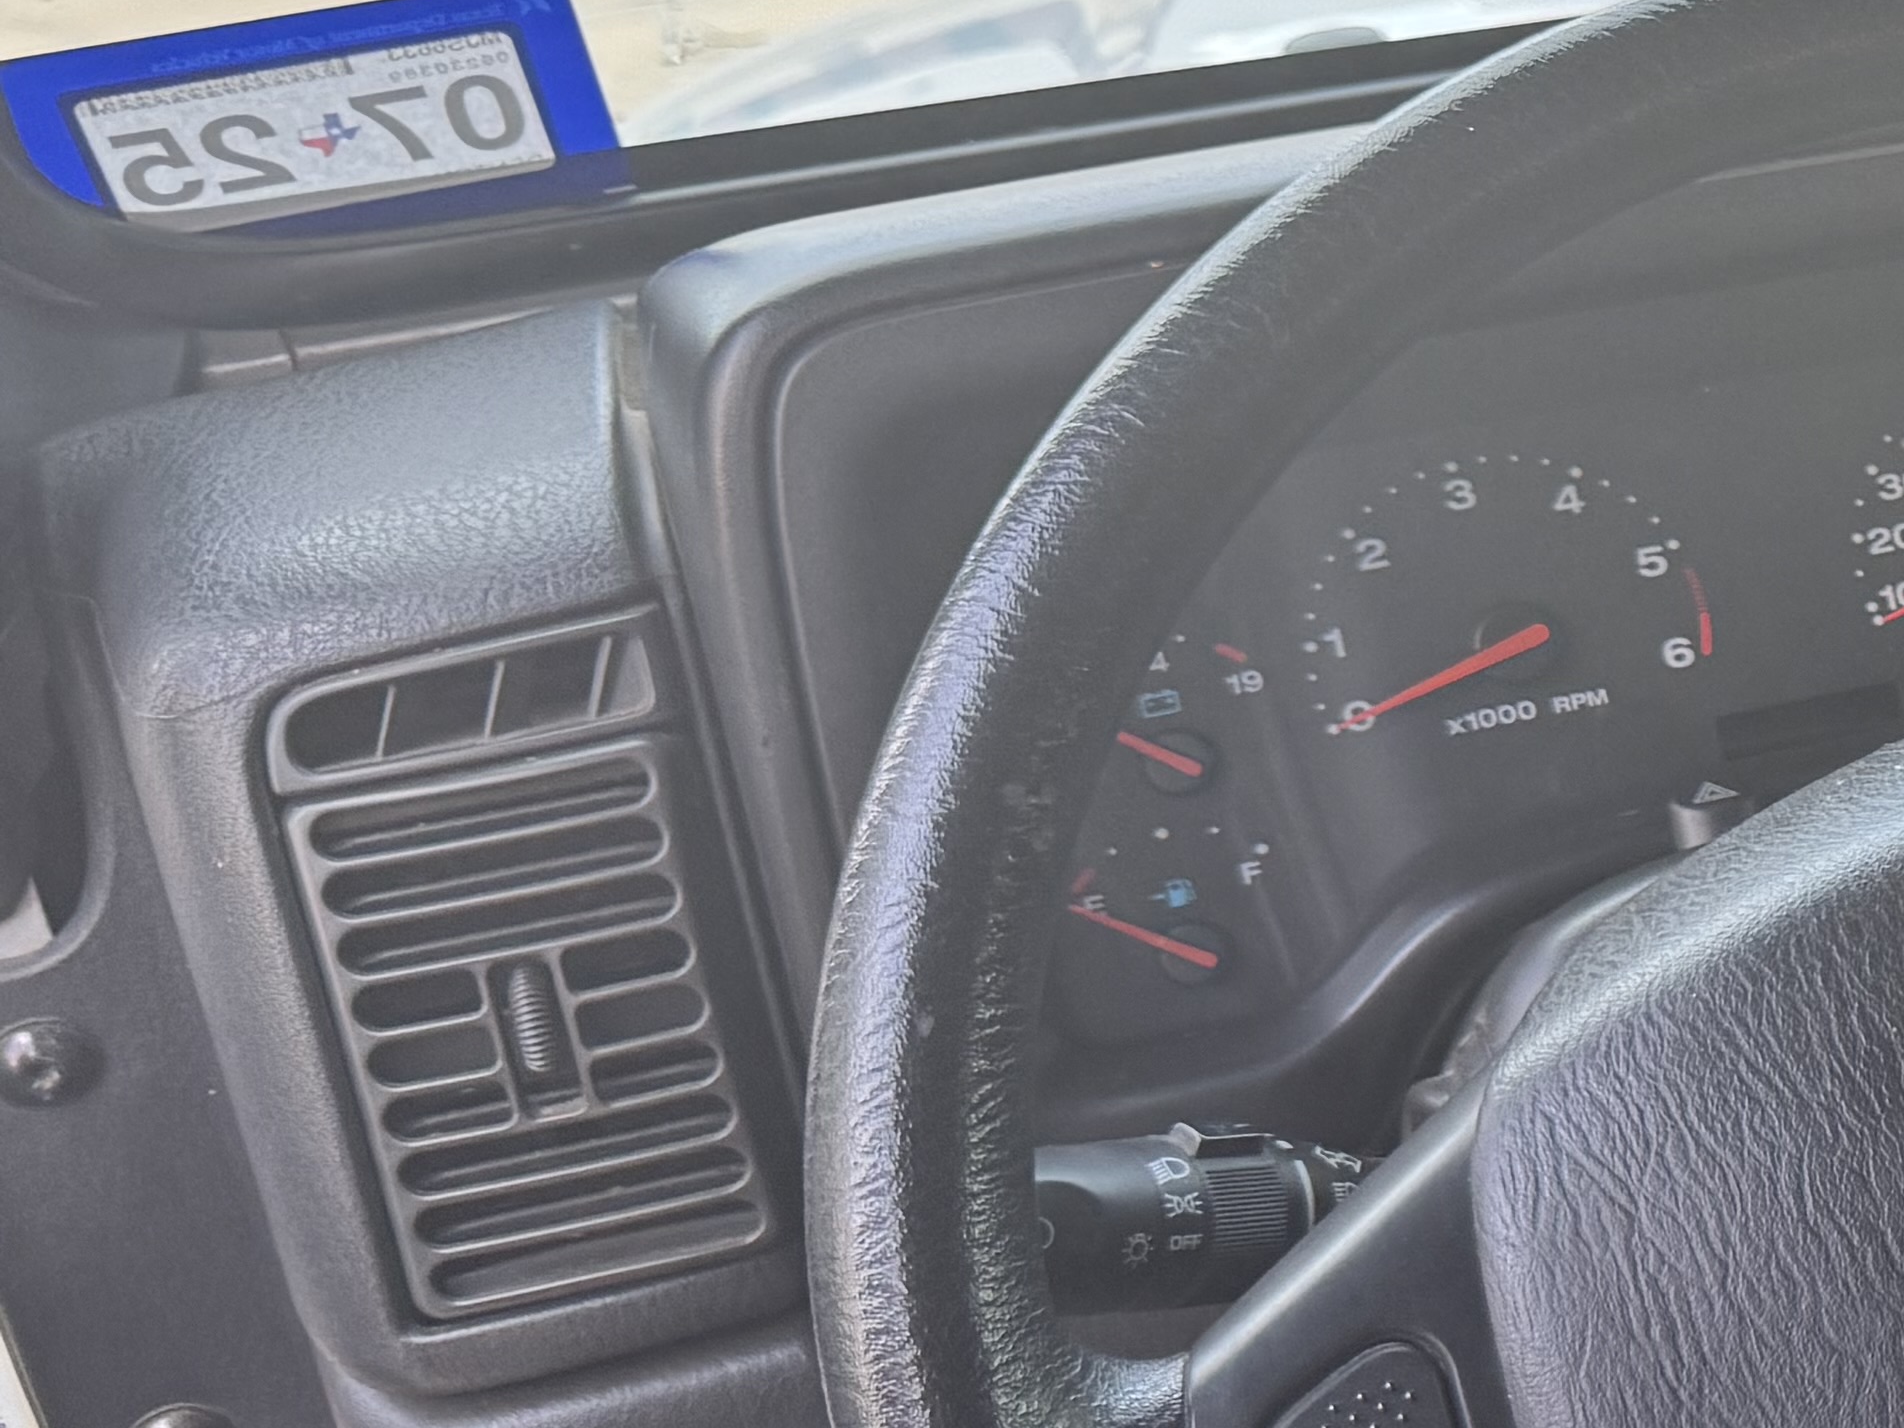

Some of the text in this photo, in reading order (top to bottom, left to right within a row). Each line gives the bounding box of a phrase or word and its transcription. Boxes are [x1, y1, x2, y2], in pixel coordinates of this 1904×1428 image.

[1444, 479, 1477, 510] 3
[1552, 485, 1586, 513] 4
[1355, 538, 1391, 571] 2
[1636, 545, 1668, 577] 5
[1322, 628, 1347, 658] 1
[1662, 637, 1695, 668] 6
[1225, 670, 1264, 694] 19
[1343, 700, 1376, 732] 0
[1447, 688, 1610, 736] x1000 RPM
[1240, 861, 1262, 885] F
[1169, 1233, 1204, 1252] OFF
